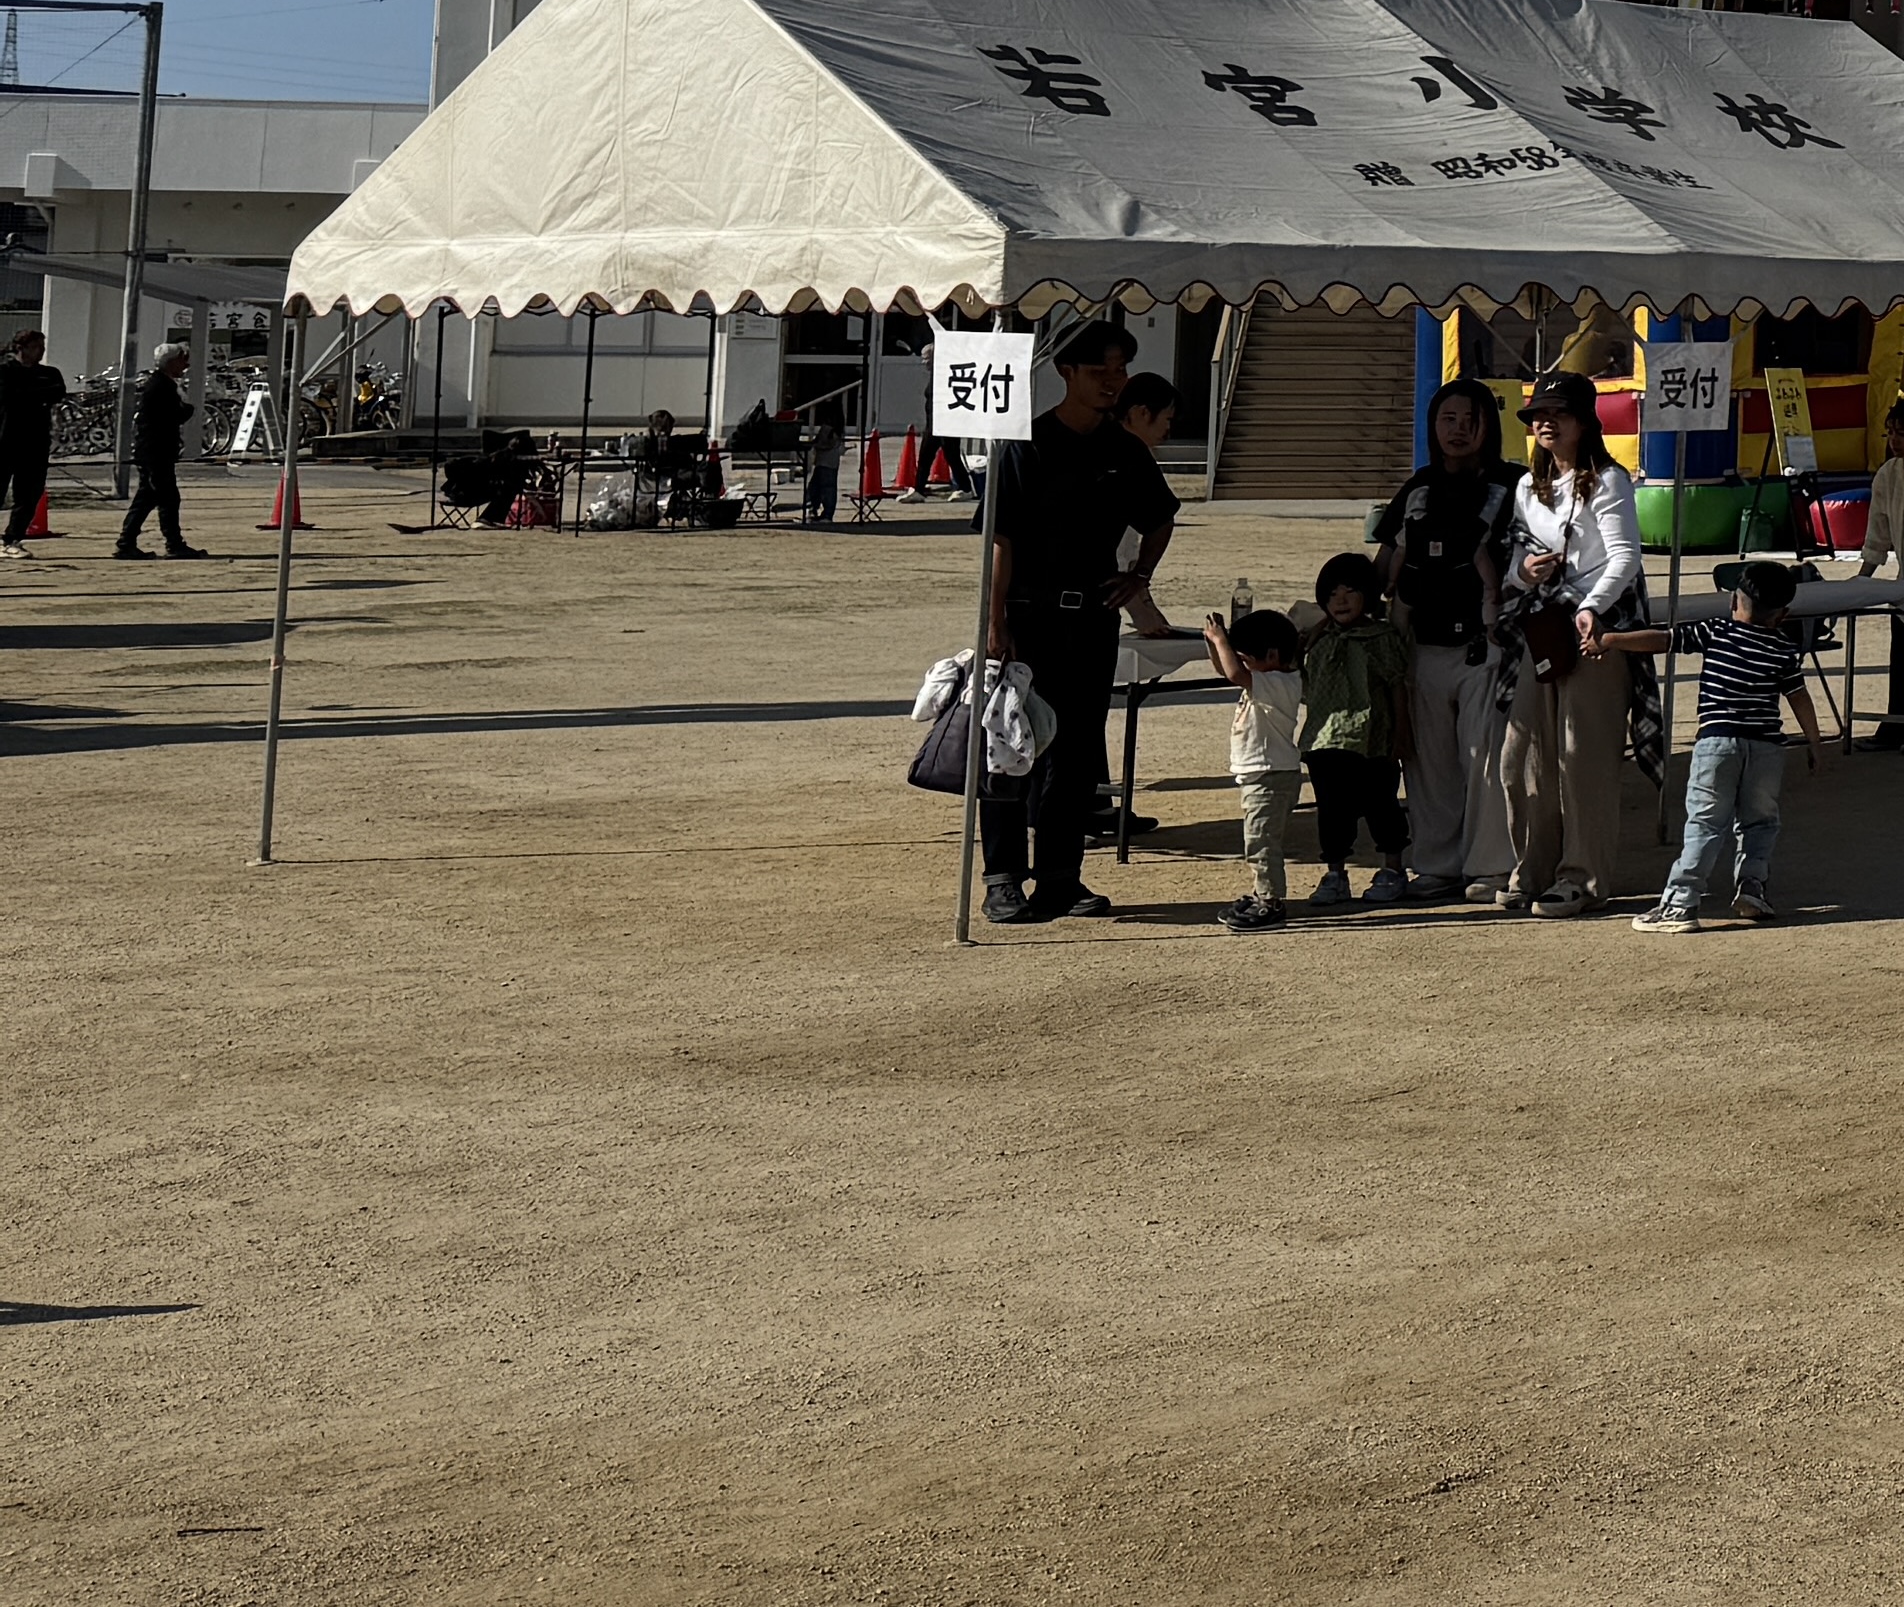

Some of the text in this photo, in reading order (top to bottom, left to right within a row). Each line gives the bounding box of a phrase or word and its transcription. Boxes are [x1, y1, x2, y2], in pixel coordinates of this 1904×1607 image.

[977, 44, 1845, 151] 若宮小学校
[947, 361, 1015, 414] 受付
[1658, 366, 1719, 409] 受付
